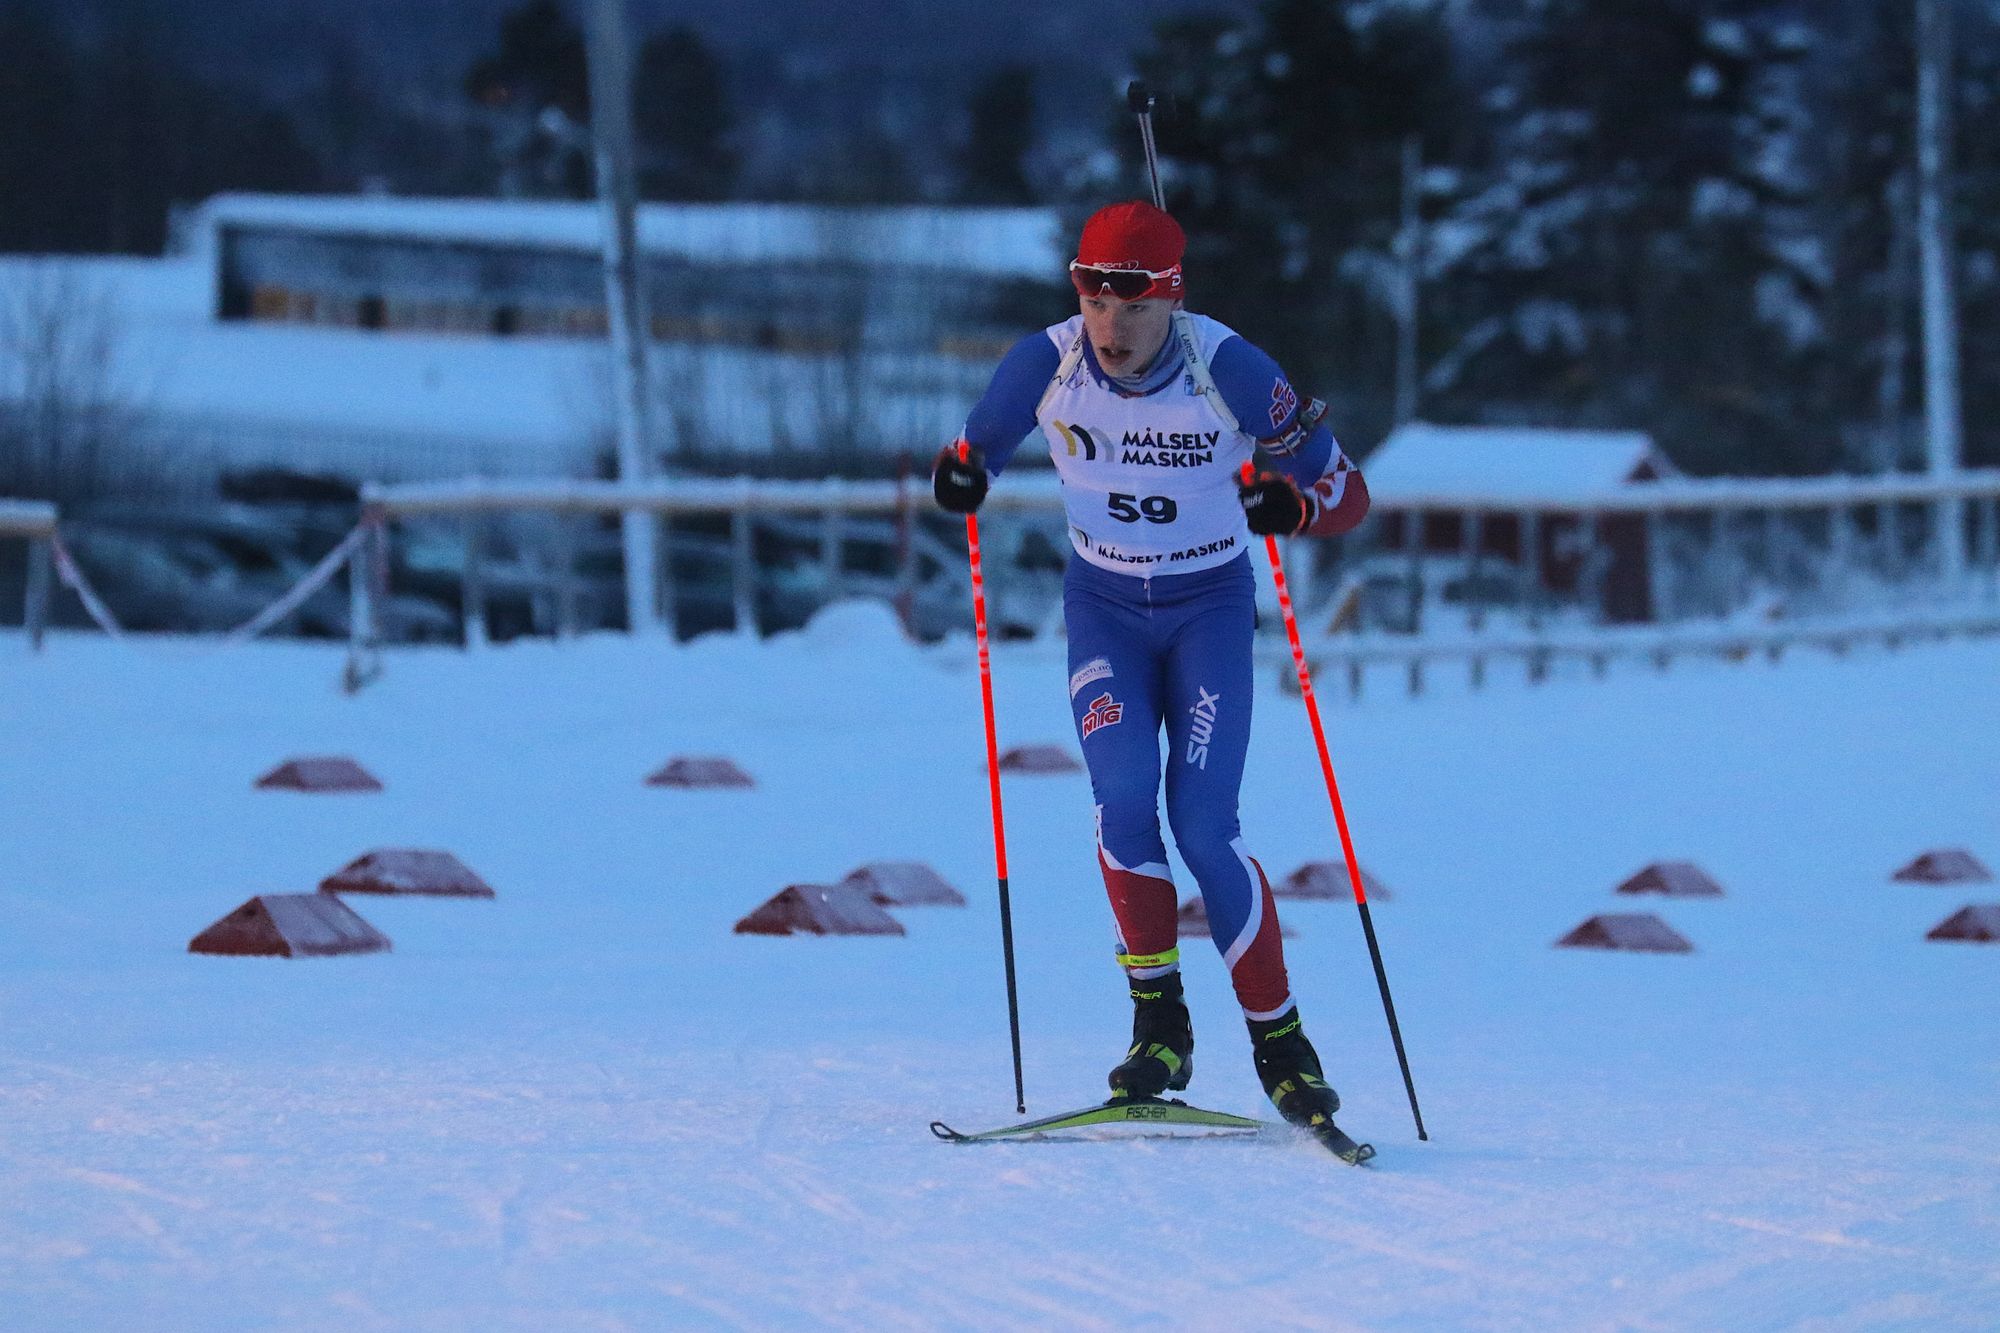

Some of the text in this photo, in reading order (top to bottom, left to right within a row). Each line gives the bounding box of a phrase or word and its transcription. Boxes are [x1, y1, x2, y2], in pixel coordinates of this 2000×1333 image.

[1122, 427, 1220, 450] MÅLSELV
[1122, 450, 1213, 467] MASKIN
[1108, 492, 1177, 524] 59
[1170, 536, 1235, 561] MASKIN
[1083, 700, 1123, 738] NTG
[1130, 989, 1163, 1000] CHER
[1264, 1018, 1300, 1040] FISCH
[1126, 1105, 1168, 1119] FISCHER
